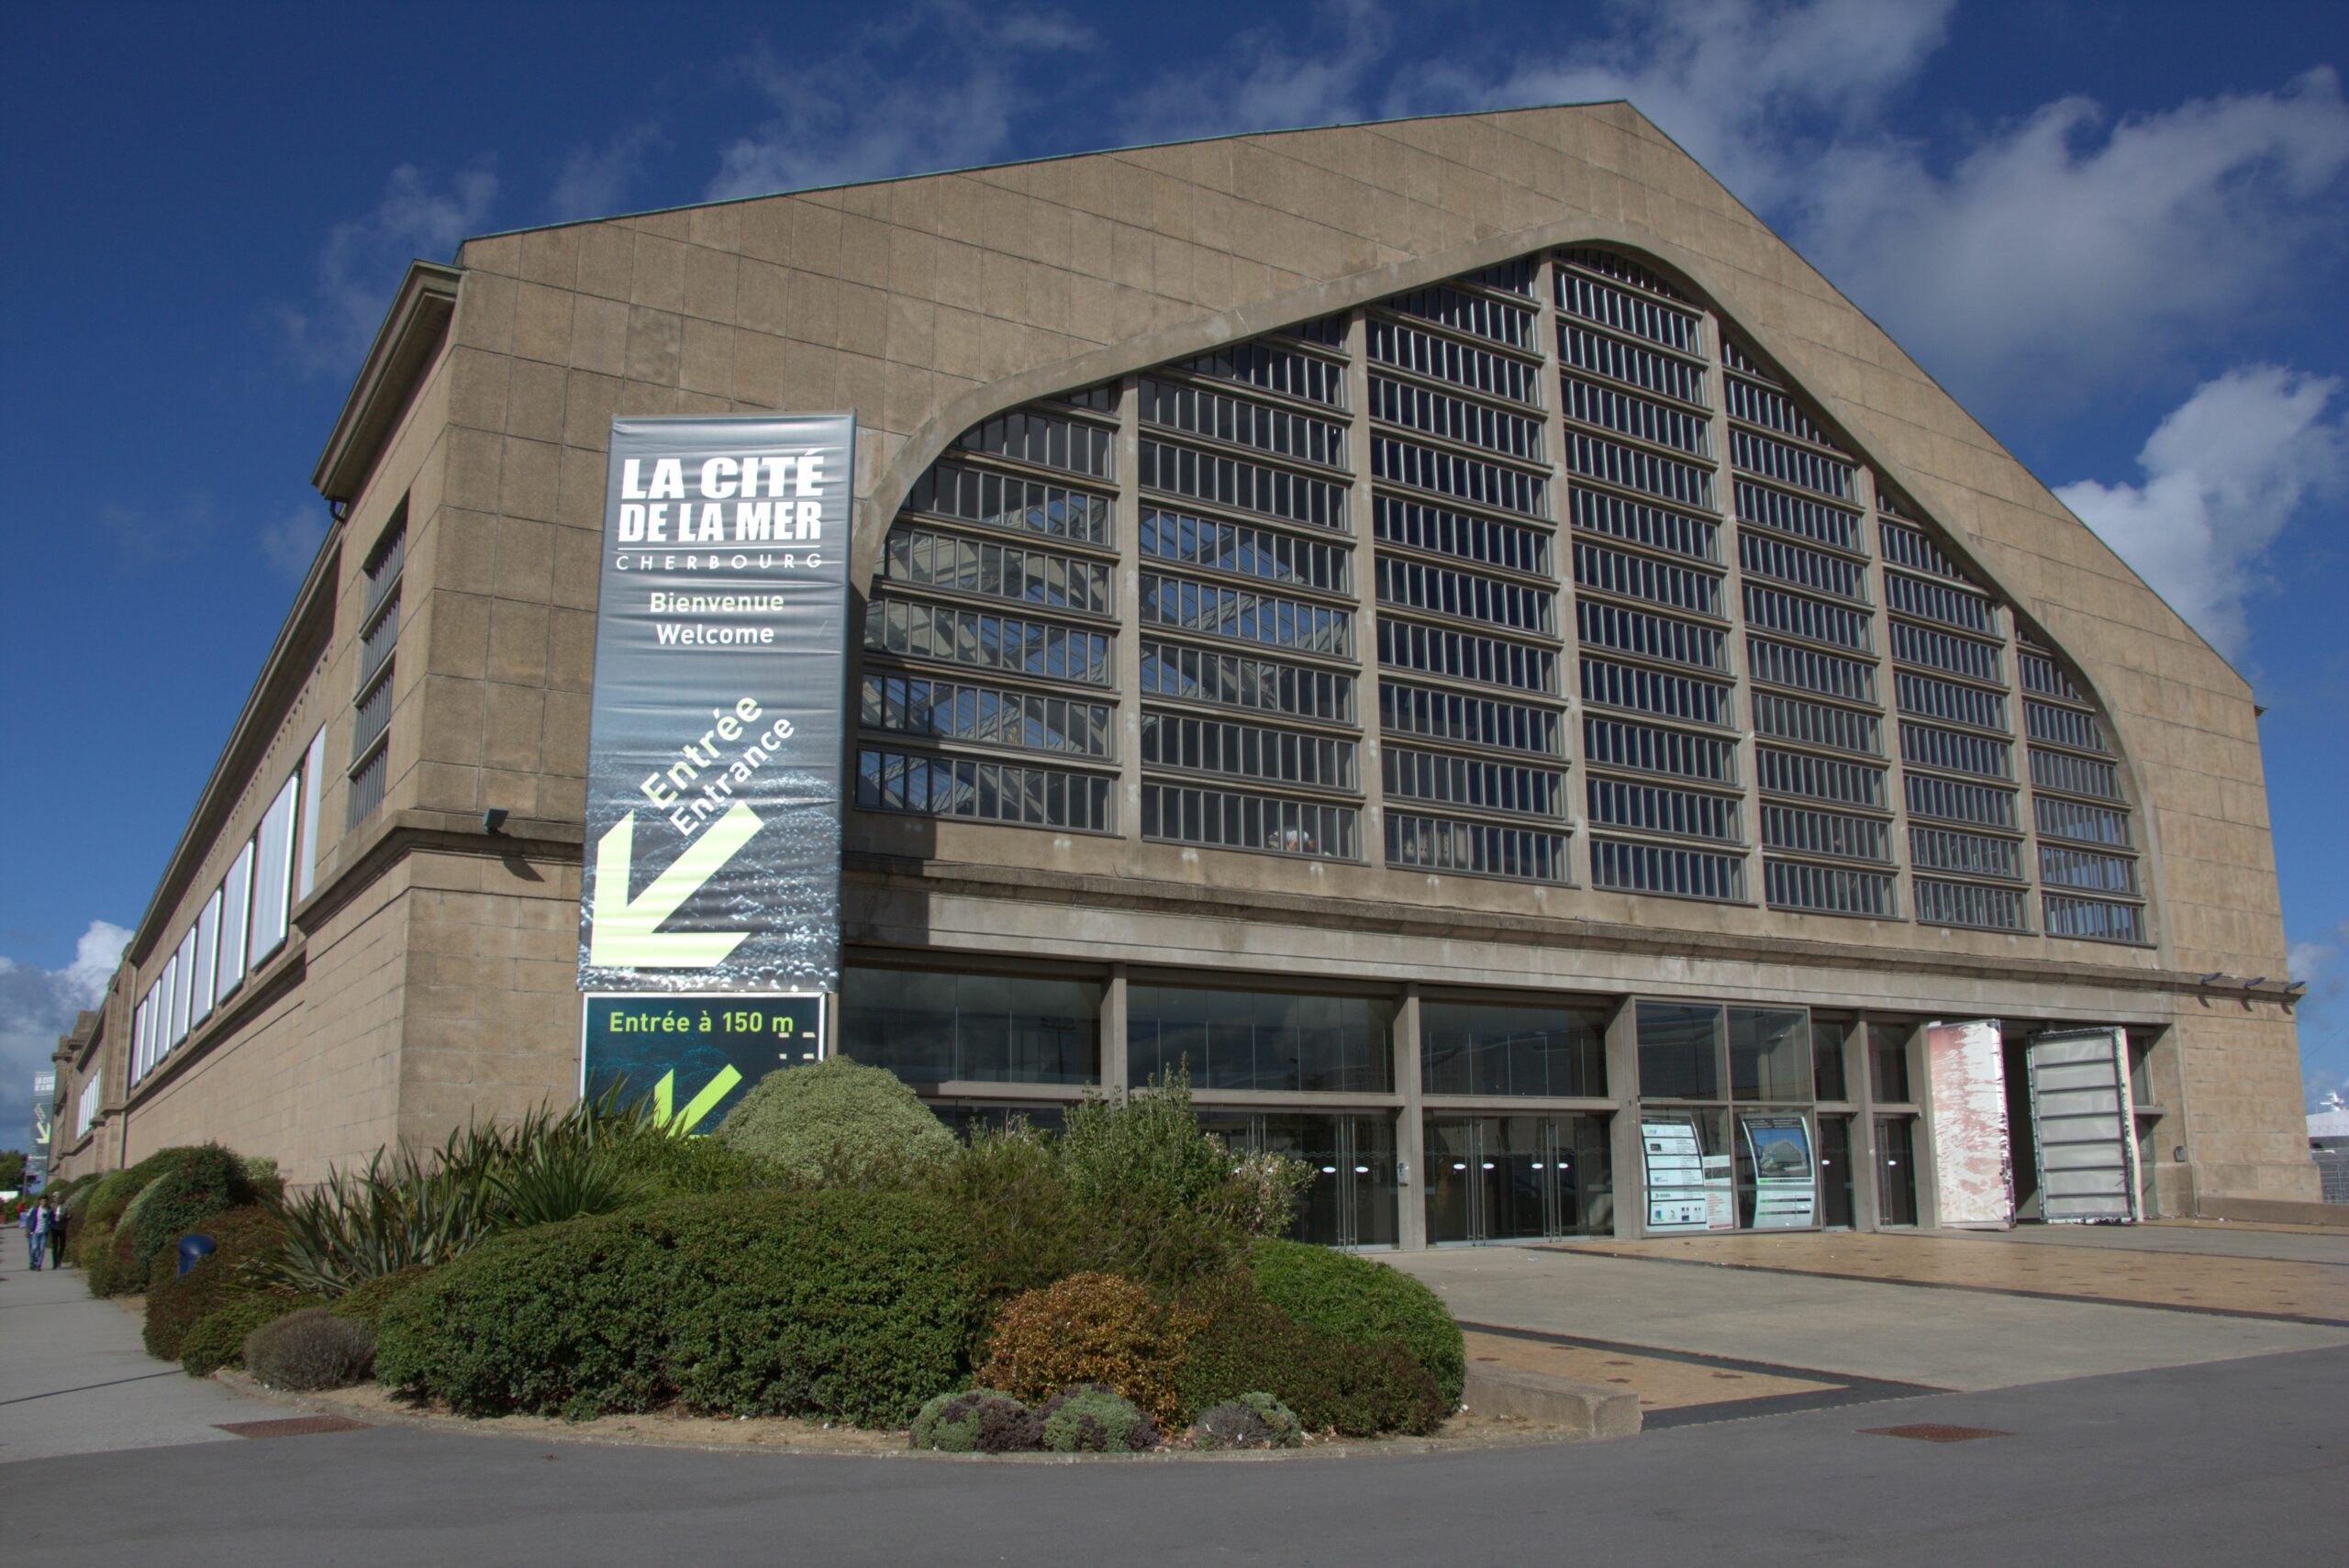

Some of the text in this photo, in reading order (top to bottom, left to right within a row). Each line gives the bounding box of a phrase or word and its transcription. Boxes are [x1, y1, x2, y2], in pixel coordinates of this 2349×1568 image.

[621, 448, 824, 499] LA CITÉ
[618, 501, 822, 542] DE LA MER
[616, 553, 822, 570] CHERBOURG
[650, 593, 785, 613] Bienvenue
[656, 625, 774, 644] Welcome
[640, 697, 763, 810] Entrée
[670, 718, 795, 837] Entrance
[609, 1011, 794, 1032] Entrée à 150 m
